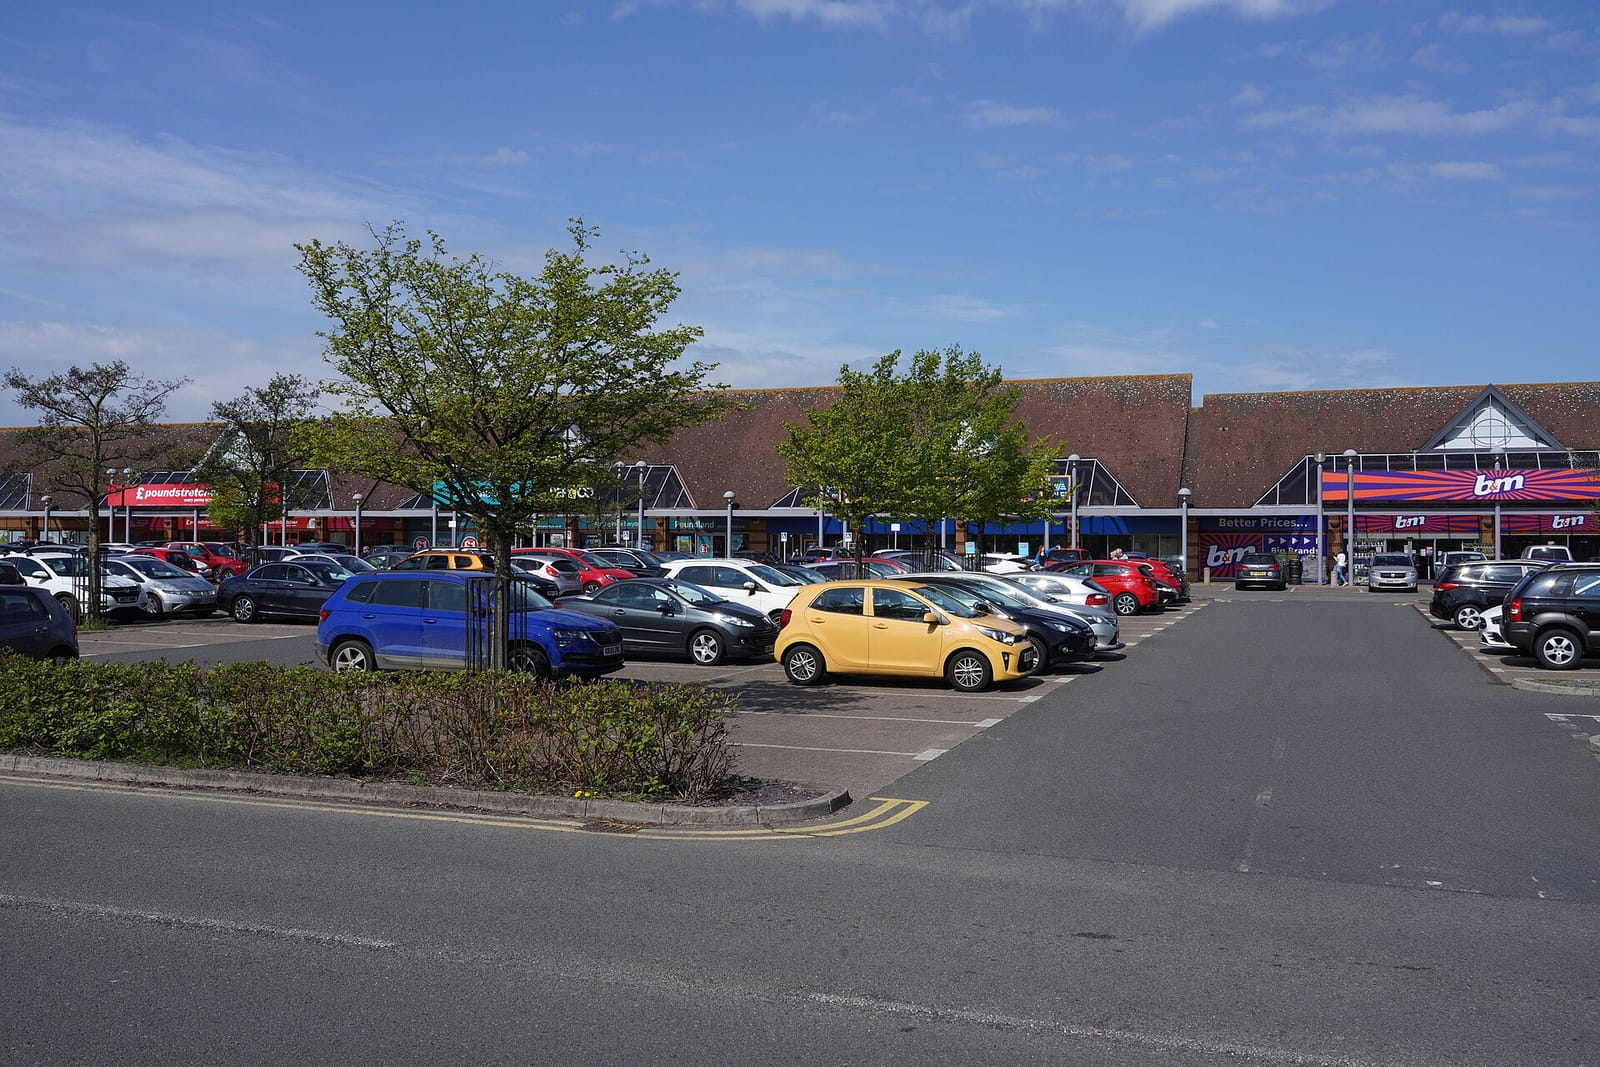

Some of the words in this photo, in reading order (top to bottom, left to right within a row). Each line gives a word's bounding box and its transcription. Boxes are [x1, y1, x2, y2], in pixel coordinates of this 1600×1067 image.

[1474, 474, 1525, 496] b&m
[136, 487, 216, 499] £poundstretc
[674, 520, 715, 529] Poundland
[1219, 518, 1257, 527] Better
[1260, 518, 1308, 527] Prices...
[1395, 515, 1425, 529] b&m
[1552, 515, 1585, 529] b&m
[1206, 545, 1256, 567] b&m
